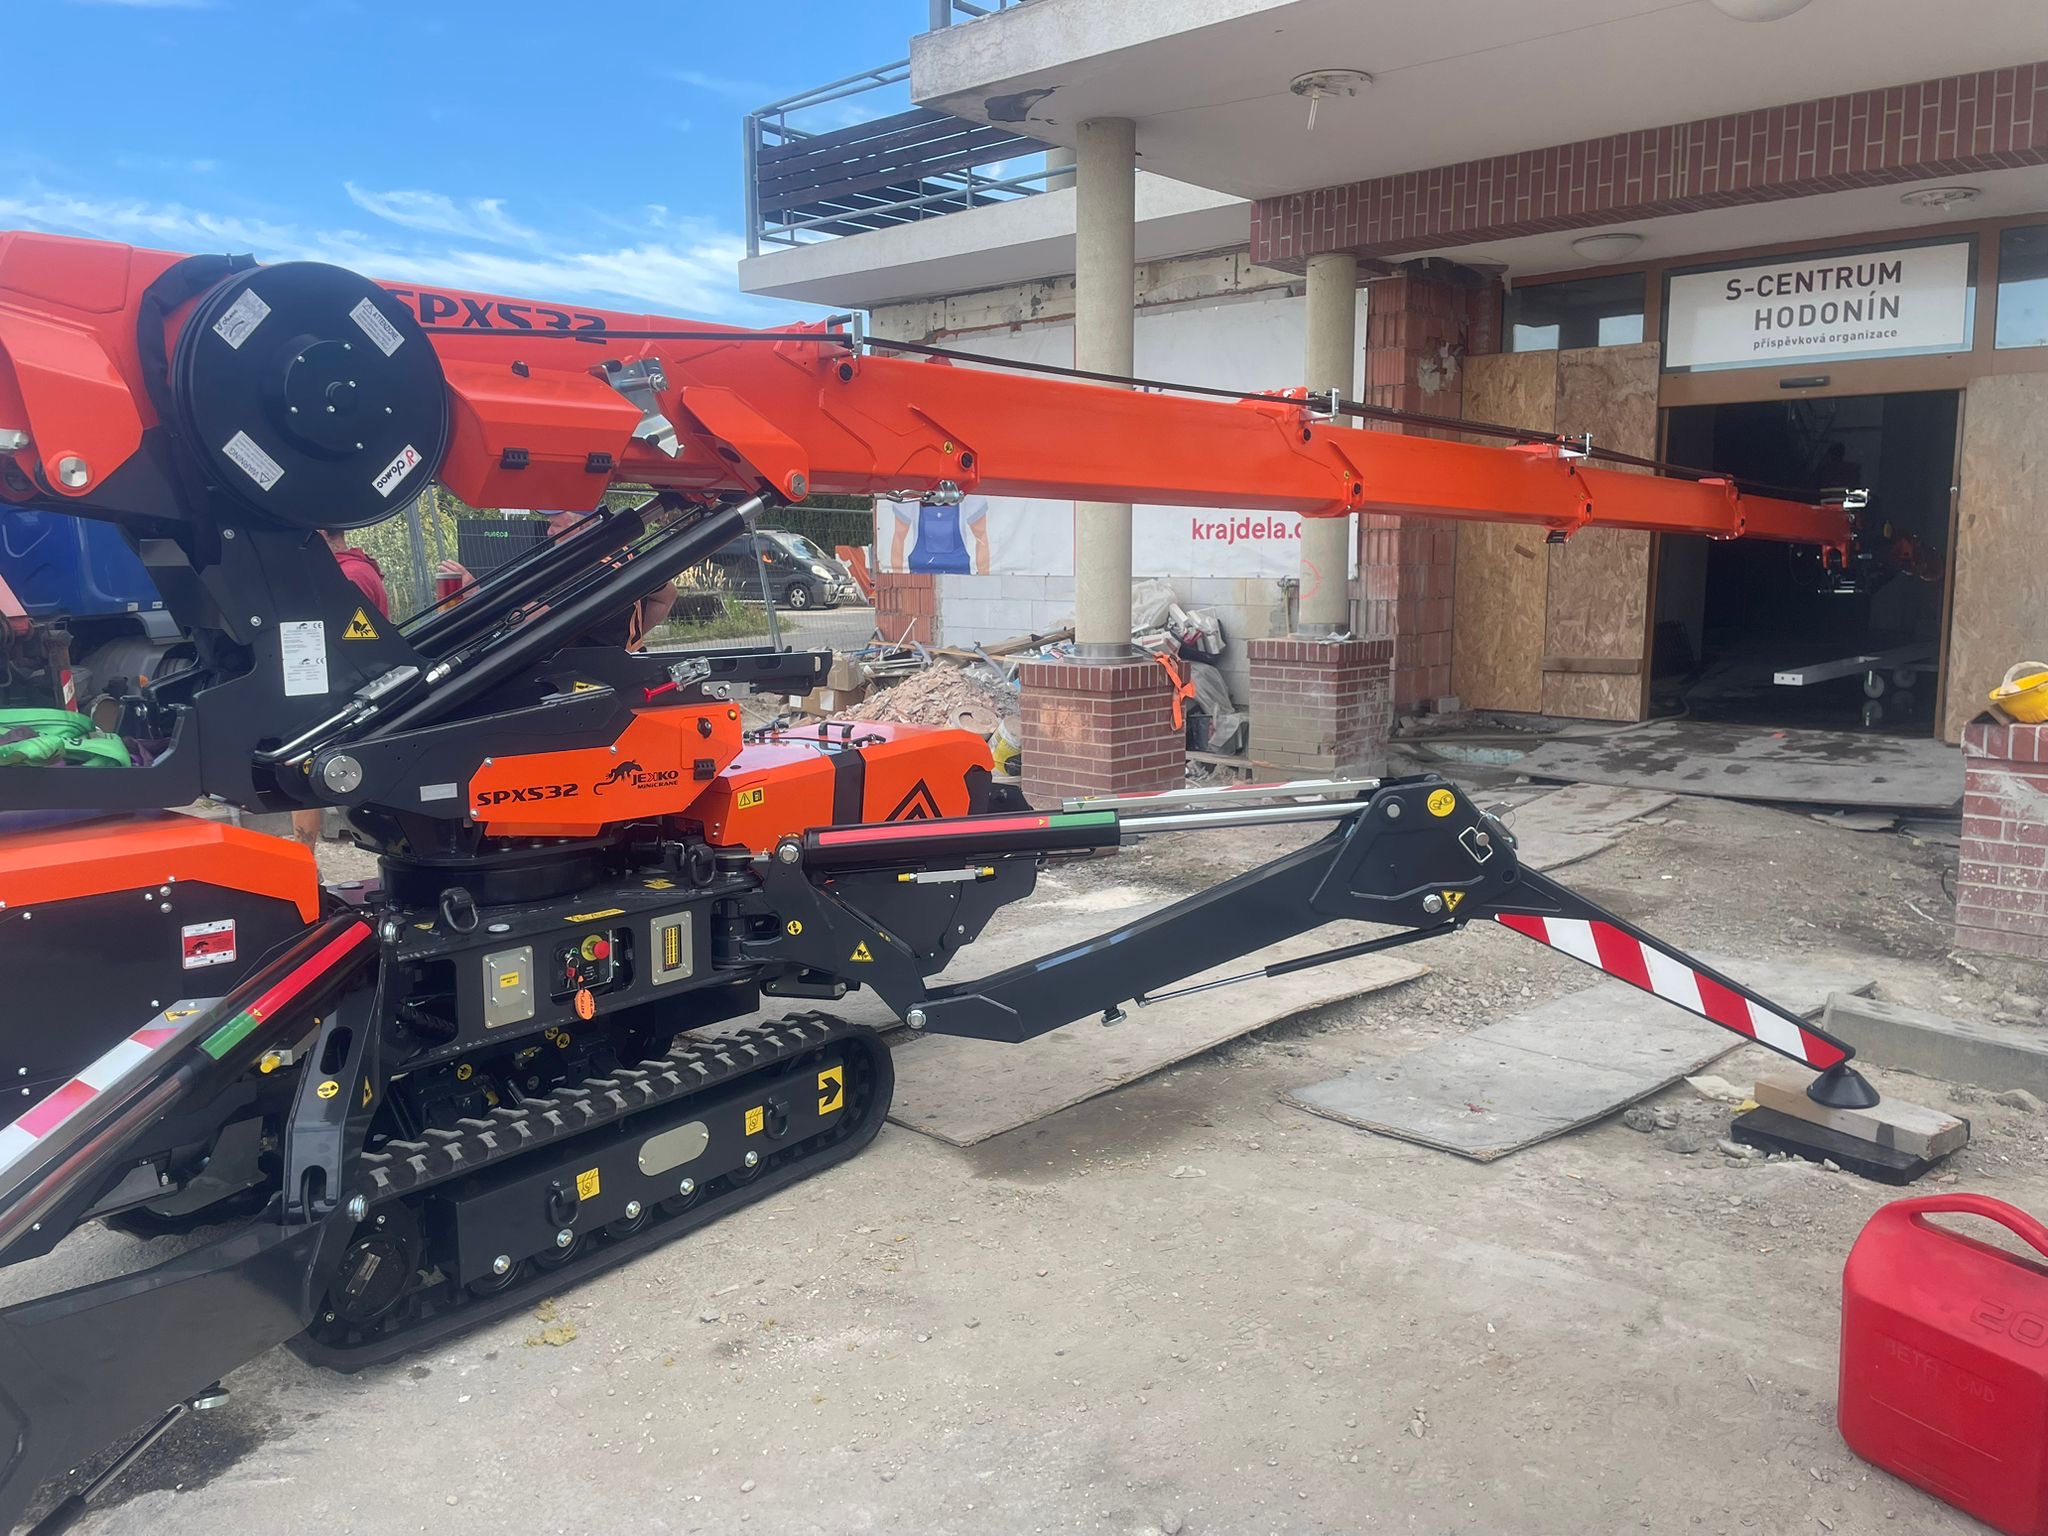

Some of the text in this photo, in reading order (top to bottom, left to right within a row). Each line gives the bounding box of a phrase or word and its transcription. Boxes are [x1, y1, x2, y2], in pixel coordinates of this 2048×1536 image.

[1726, 261, 1902, 300] S-CENTRUM
[1754, 290, 1900, 331] HODONÍN
[1753, 328, 1898, 350] příspěvková organizace
[229, 447, 260, 478] WARNING
[631, 770, 679, 786] JEKKO
